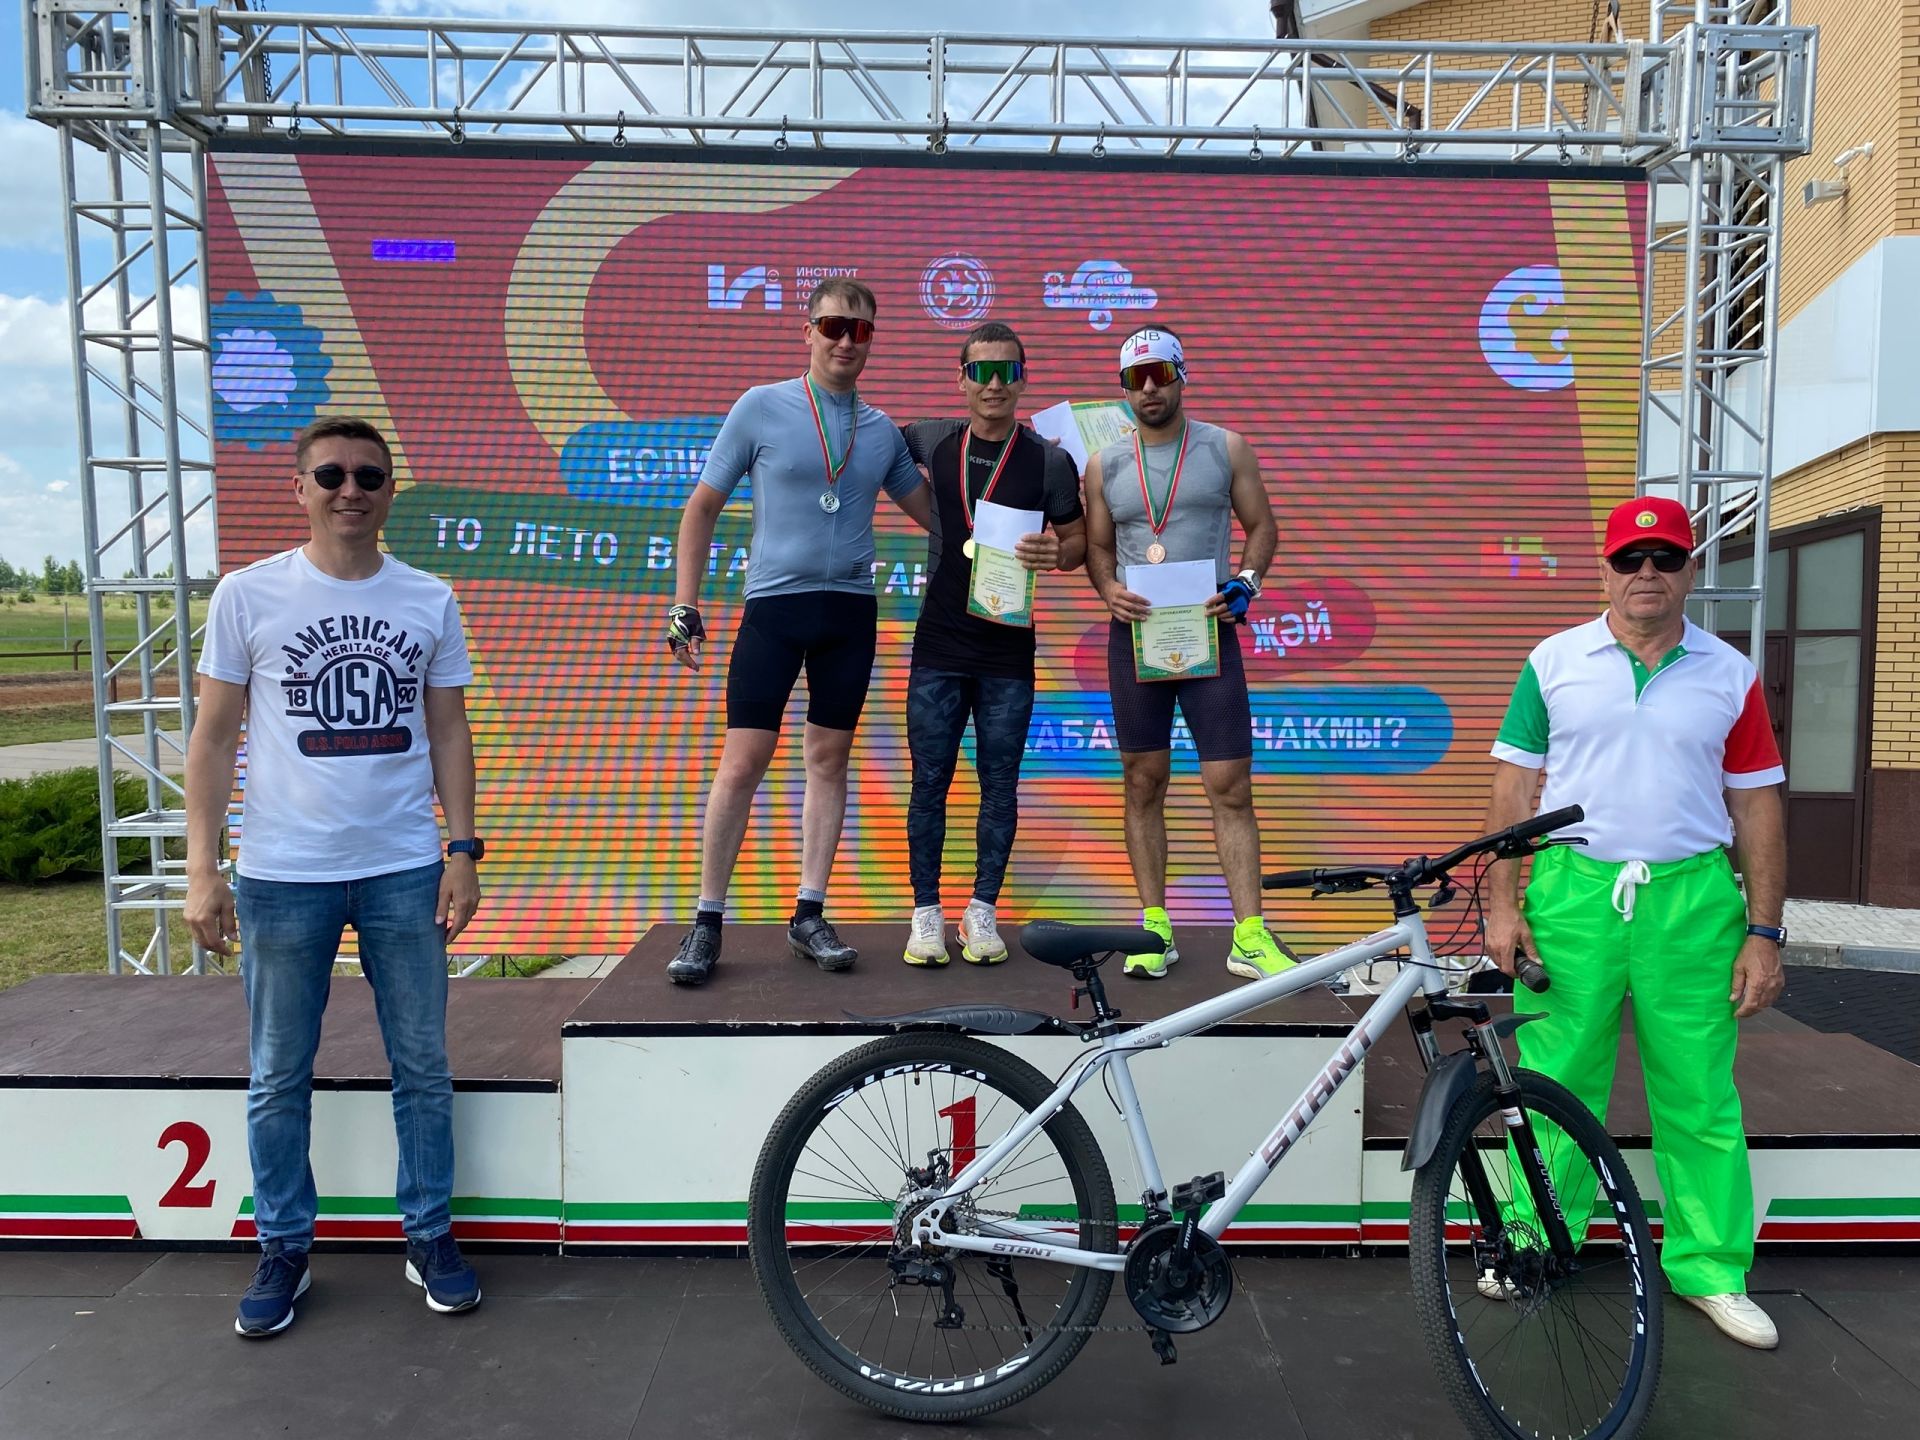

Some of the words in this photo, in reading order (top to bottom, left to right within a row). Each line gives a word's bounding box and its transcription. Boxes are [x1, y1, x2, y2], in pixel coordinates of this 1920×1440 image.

[796, 266, 858, 278] ИНСТИТУТ
[1125, 329, 1161, 352] DNB
[429, 513, 483, 551] ТО
[509, 522, 619, 565] ЛЕТО
[647, 536, 673, 569] В
[281, 615, 423, 667] AMERICAN
[320, 642, 392, 661] HERITAGE
[285, 688, 308, 707] 18
[322, 661, 394, 726] USA
[397, 686, 418, 704] 90
[1260, 1018, 1372, 1170] STANT
[938, 1095, 977, 1179] 1
[157, 1121, 217, 1208] 2
[991, 1242, 1056, 1258] STANT
